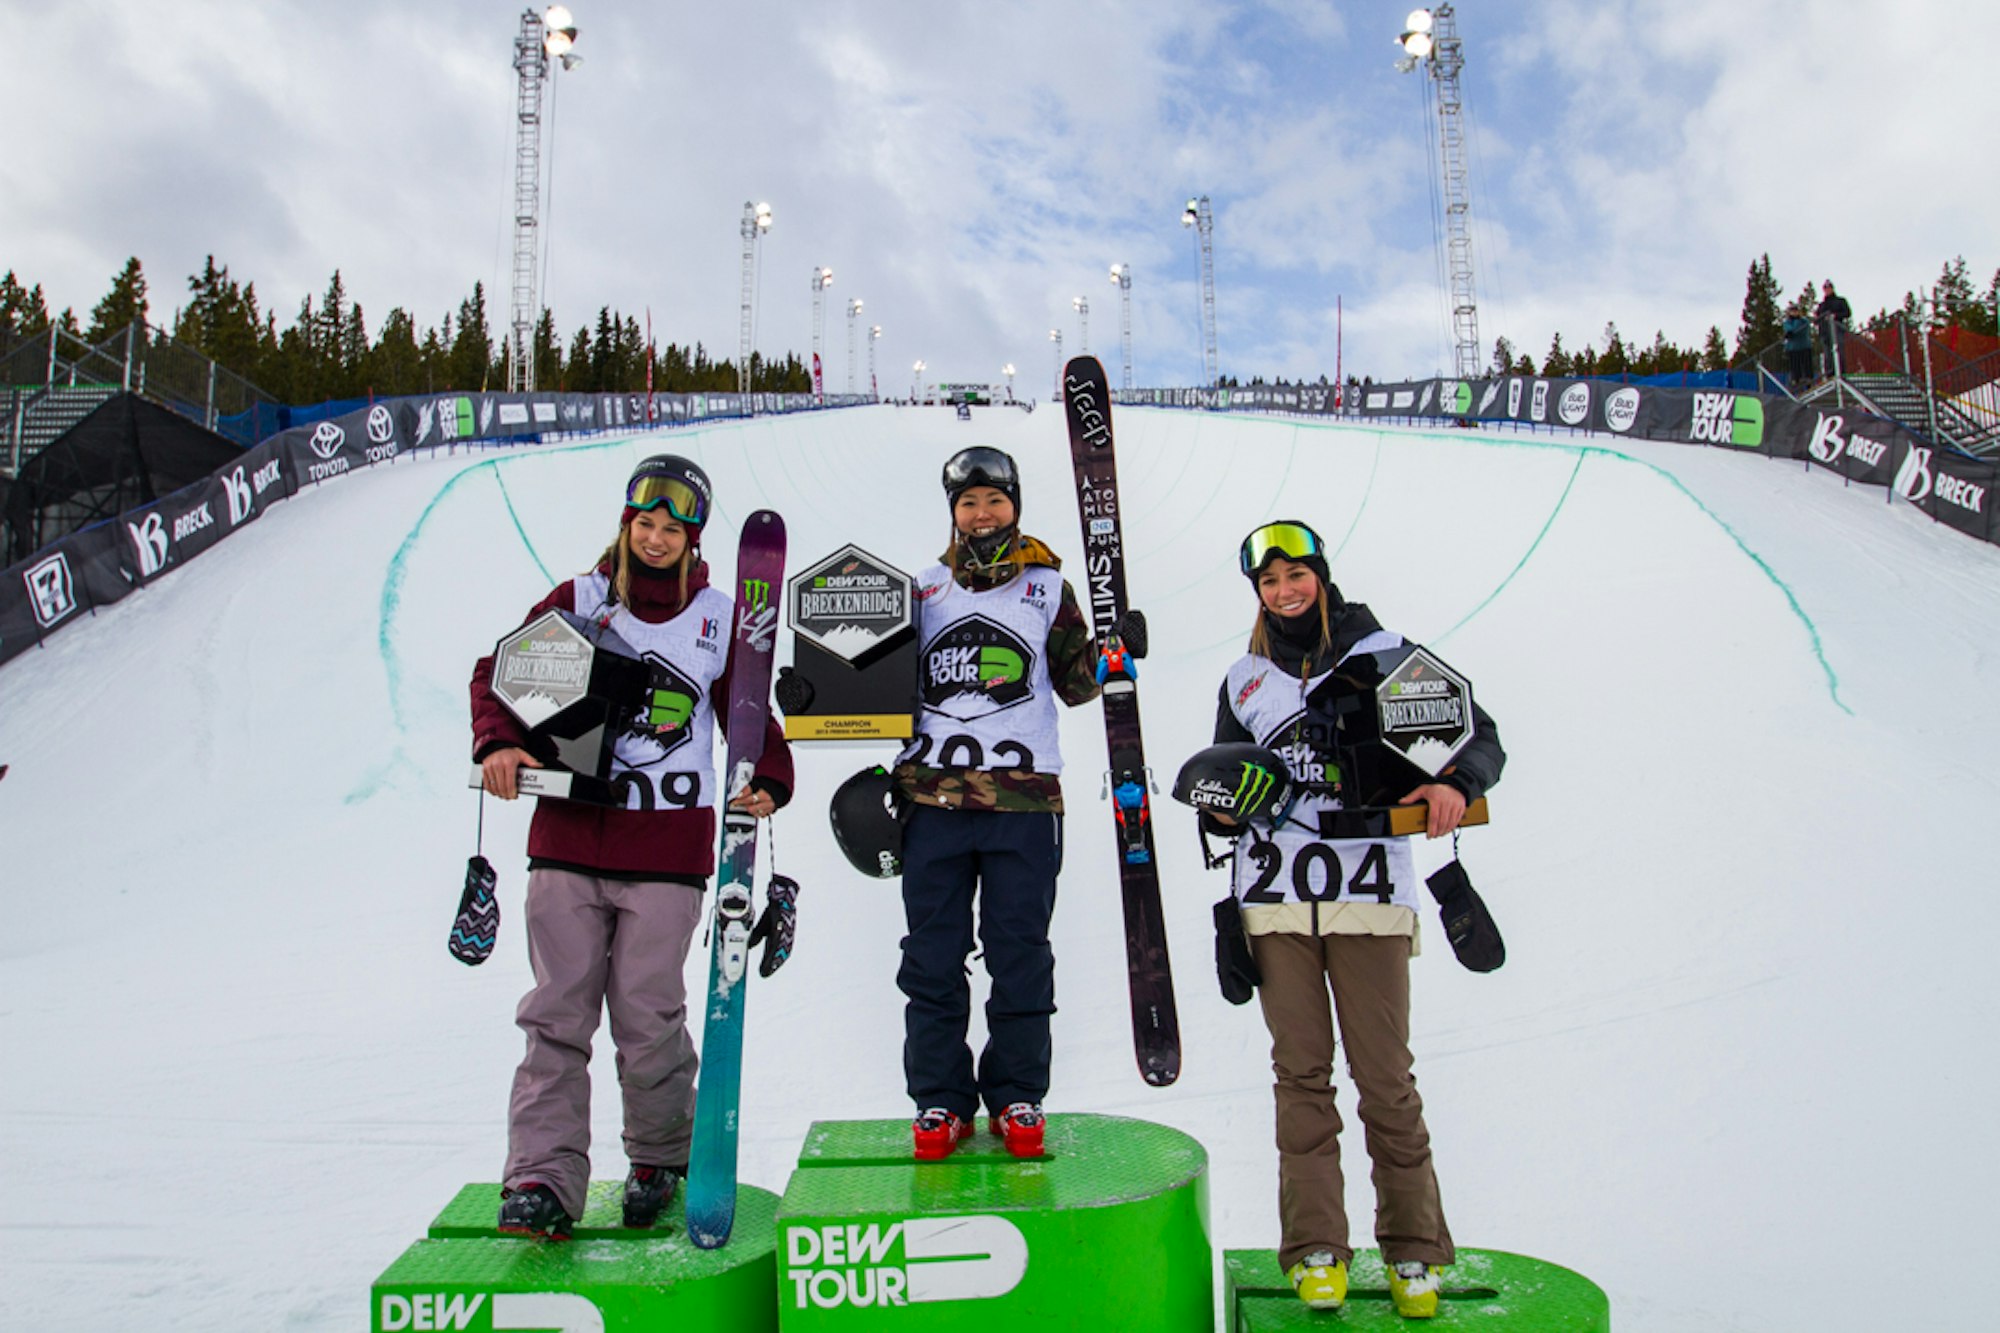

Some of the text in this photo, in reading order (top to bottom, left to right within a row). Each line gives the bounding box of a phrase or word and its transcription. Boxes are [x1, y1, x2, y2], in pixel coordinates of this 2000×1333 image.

[1614, 397, 1635, 410] BUD
[1693, 392, 1735, 419] DEW
[1689, 417, 1733, 444] TOUR
[308, 457, 349, 481] TOYOTA
[1934, 471, 1985, 514] BRECK
[174, 501, 214, 541] BRECK
[800, 590, 903, 620] BRECKENRIDGE
[504, 656, 588, 688] BRECKENRIDGE
[929, 646, 981, 671] DEW
[930, 663, 980, 688] TOUR
[824, 720, 871, 728] CHAMPION
[1382, 697, 1463, 733] BRECKENRIDGE
[609, 770, 701, 810] 09
[1190, 789, 1236, 808] GIRO
[1243, 841, 1395, 904] 204
[786, 1223, 904, 1266] DEW
[788, 1267, 909, 1309] TOUR
[381, 1293, 487, 1331] DEW
